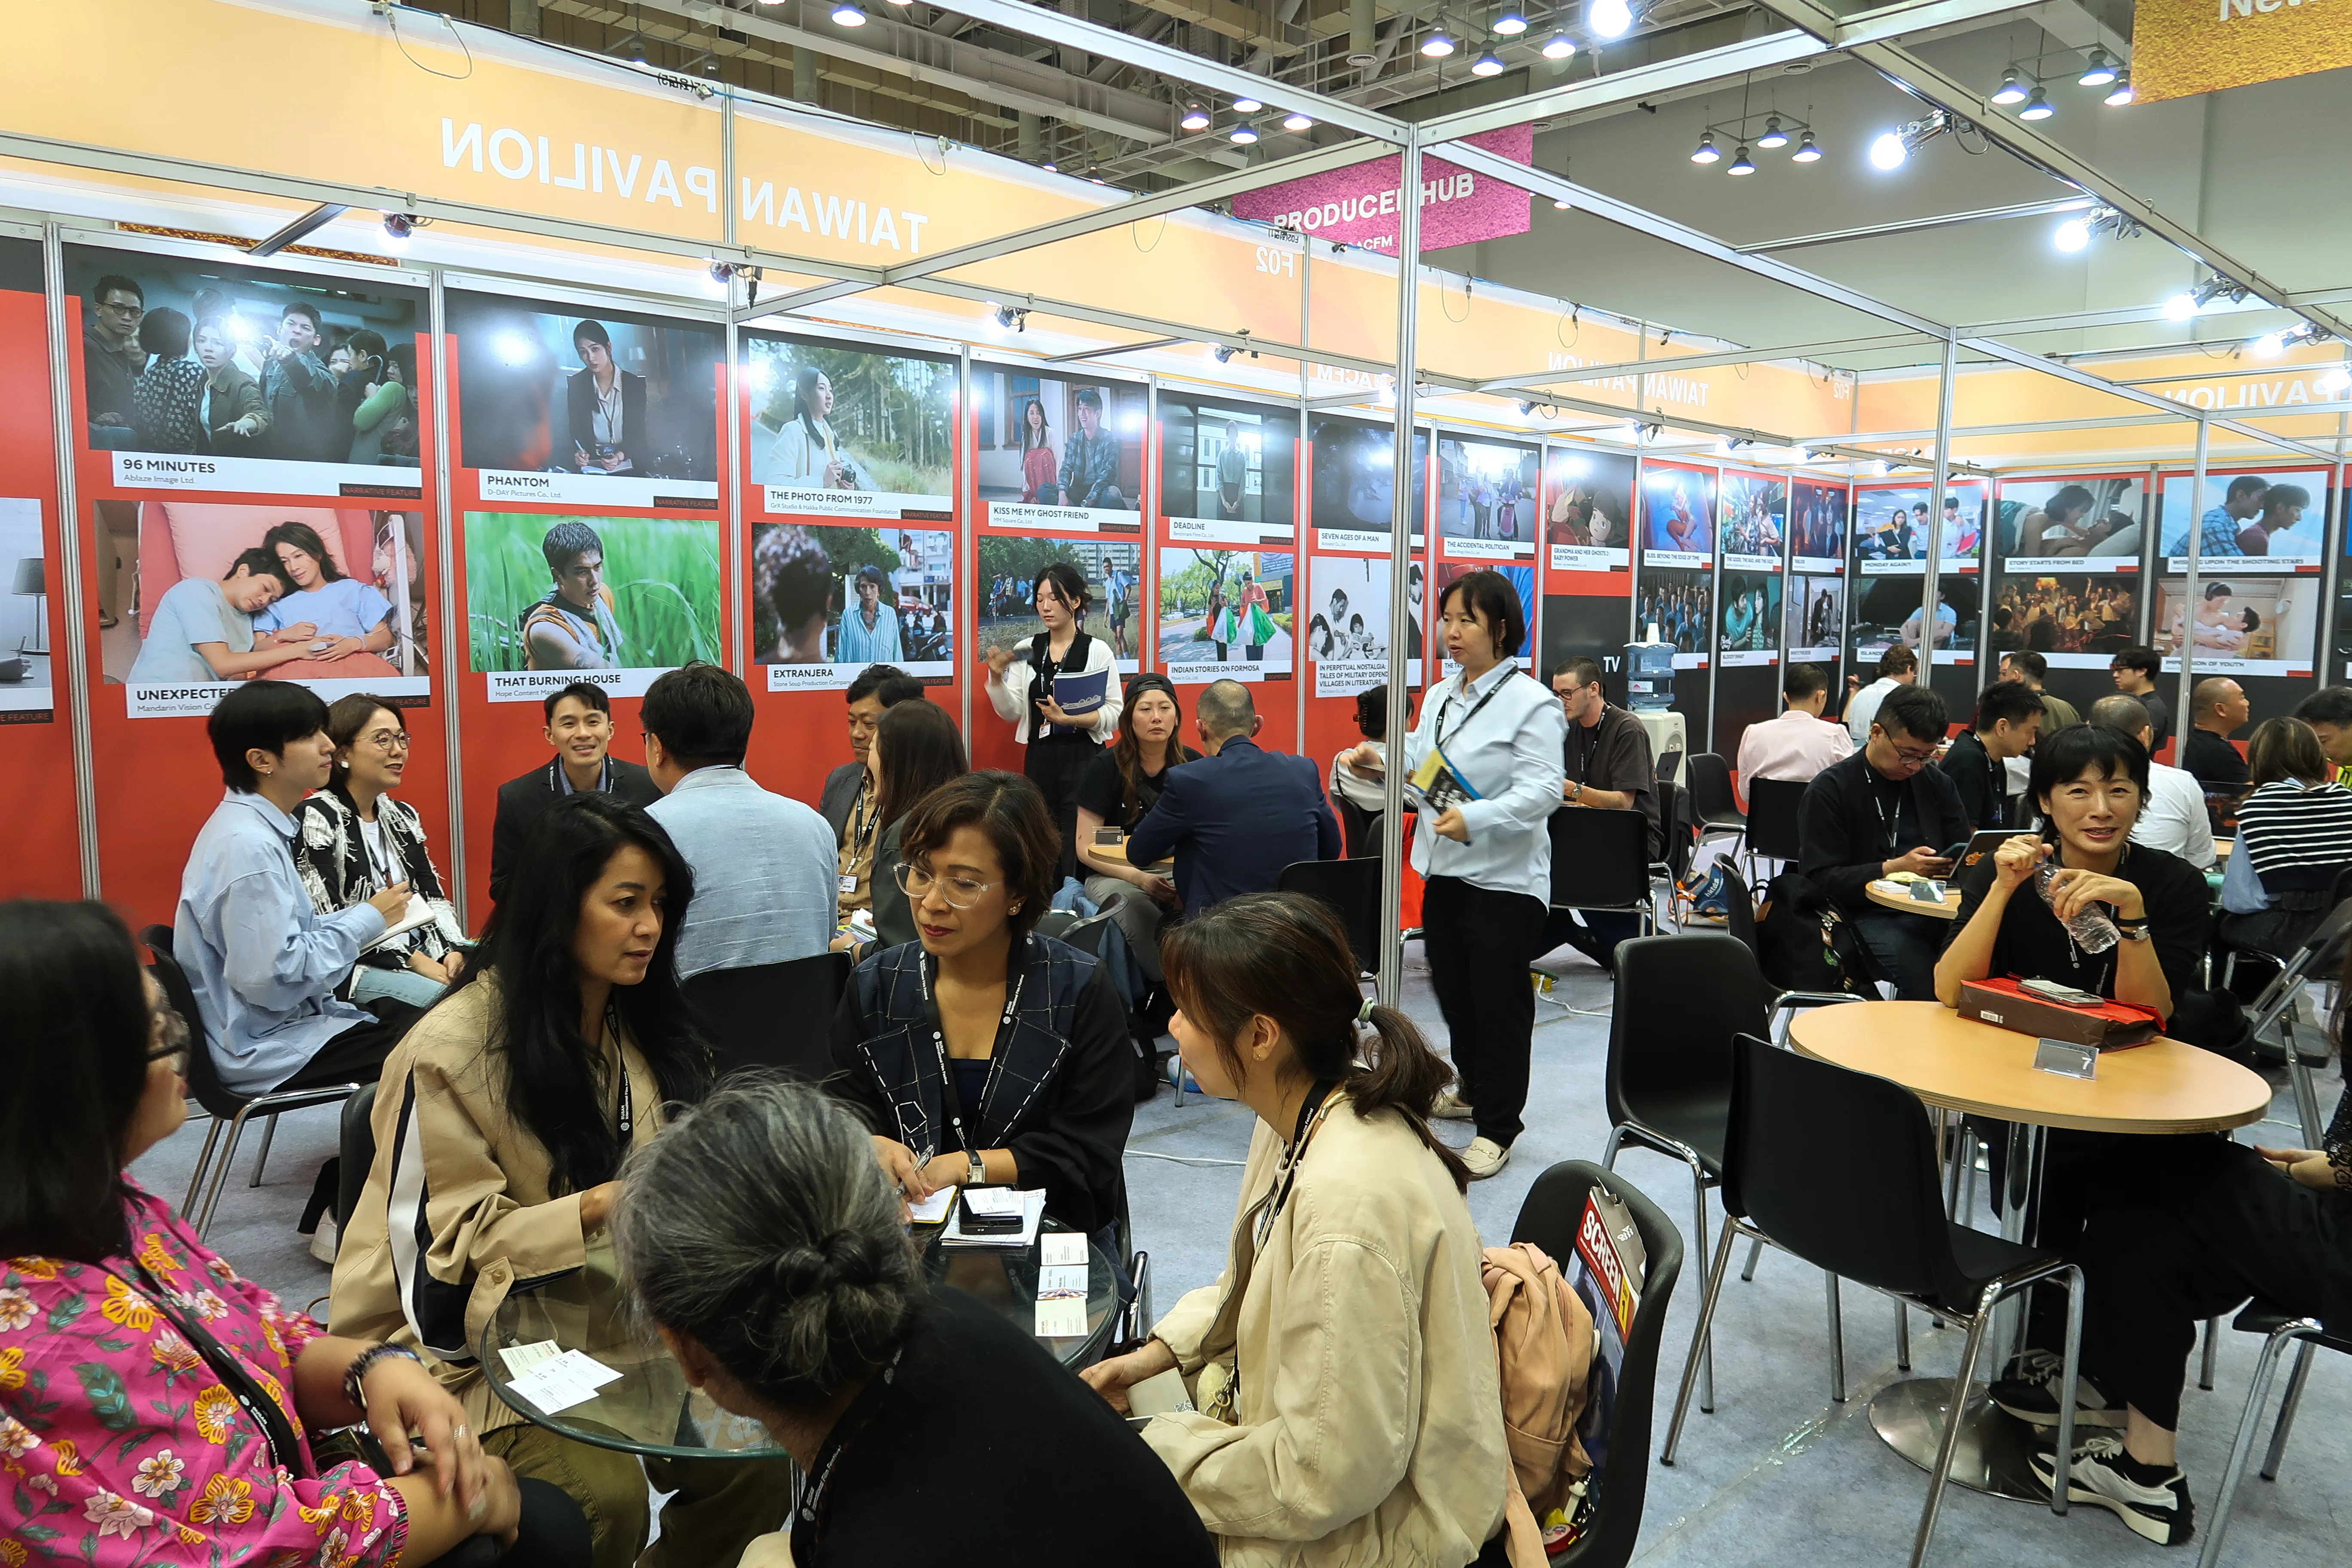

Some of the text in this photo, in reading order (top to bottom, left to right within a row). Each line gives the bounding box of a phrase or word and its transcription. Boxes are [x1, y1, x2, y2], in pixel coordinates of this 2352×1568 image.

[1421, 173, 1474, 206] HUB
[123, 459, 216, 473] 96 MINUTES
[154, 476, 179, 485] Image
[487, 476, 549, 487] PHANTOM
[388, 488, 418, 497] FEATURE
[770, 491, 873, 505] THE PHOTO FROM 1977
[1038, 510, 1062, 518] GHOST
[1174, 522, 1205, 530] DEADLINE
[1603, 656, 1620, 672] TV
[774, 669, 833, 678] EXTRANJERA
[495, 674, 621, 687] THAT BURNING HOUSE
[7, 713, 49, 722] FEATURE
[2082, 1057, 2092, 1070] 7
[1583, 1210, 1621, 1302] SCREEN
